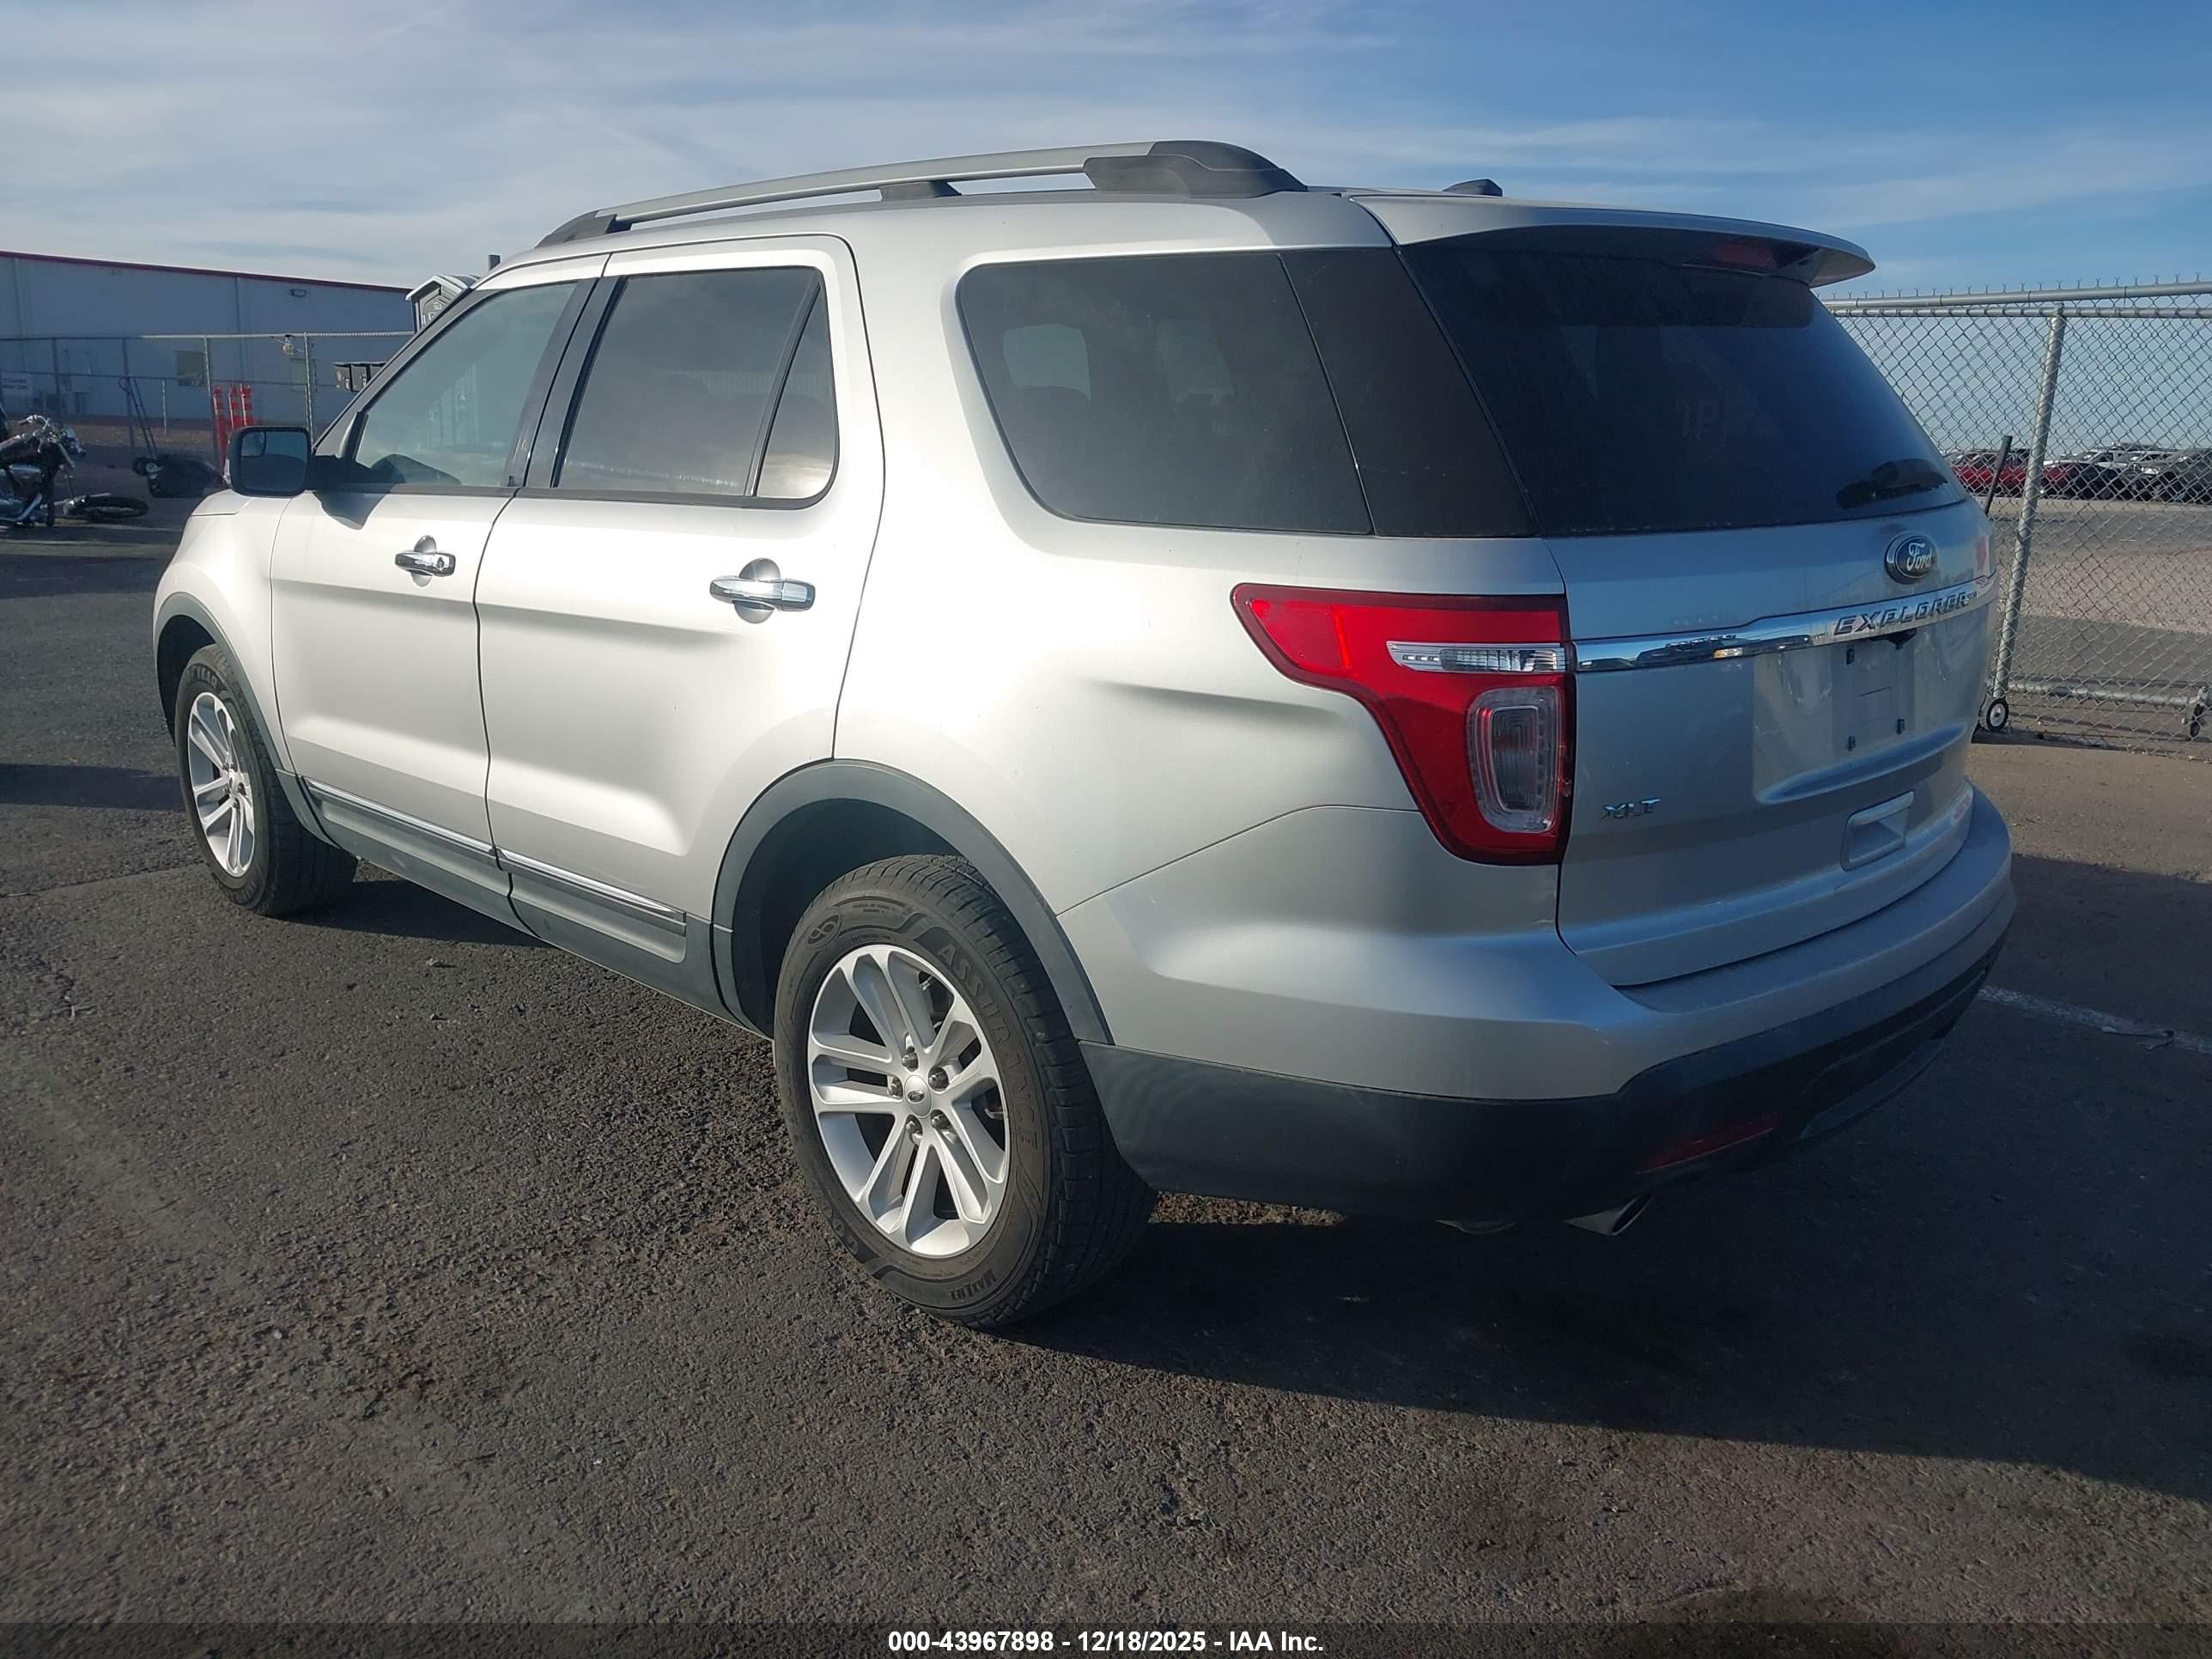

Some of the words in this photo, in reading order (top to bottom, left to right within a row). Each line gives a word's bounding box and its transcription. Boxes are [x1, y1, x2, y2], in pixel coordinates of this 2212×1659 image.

[1906, 542, 1932, 571] Ford
[1833, 592, 1971, 635] EXPLORER
[1601, 799, 1661, 819] XLT
